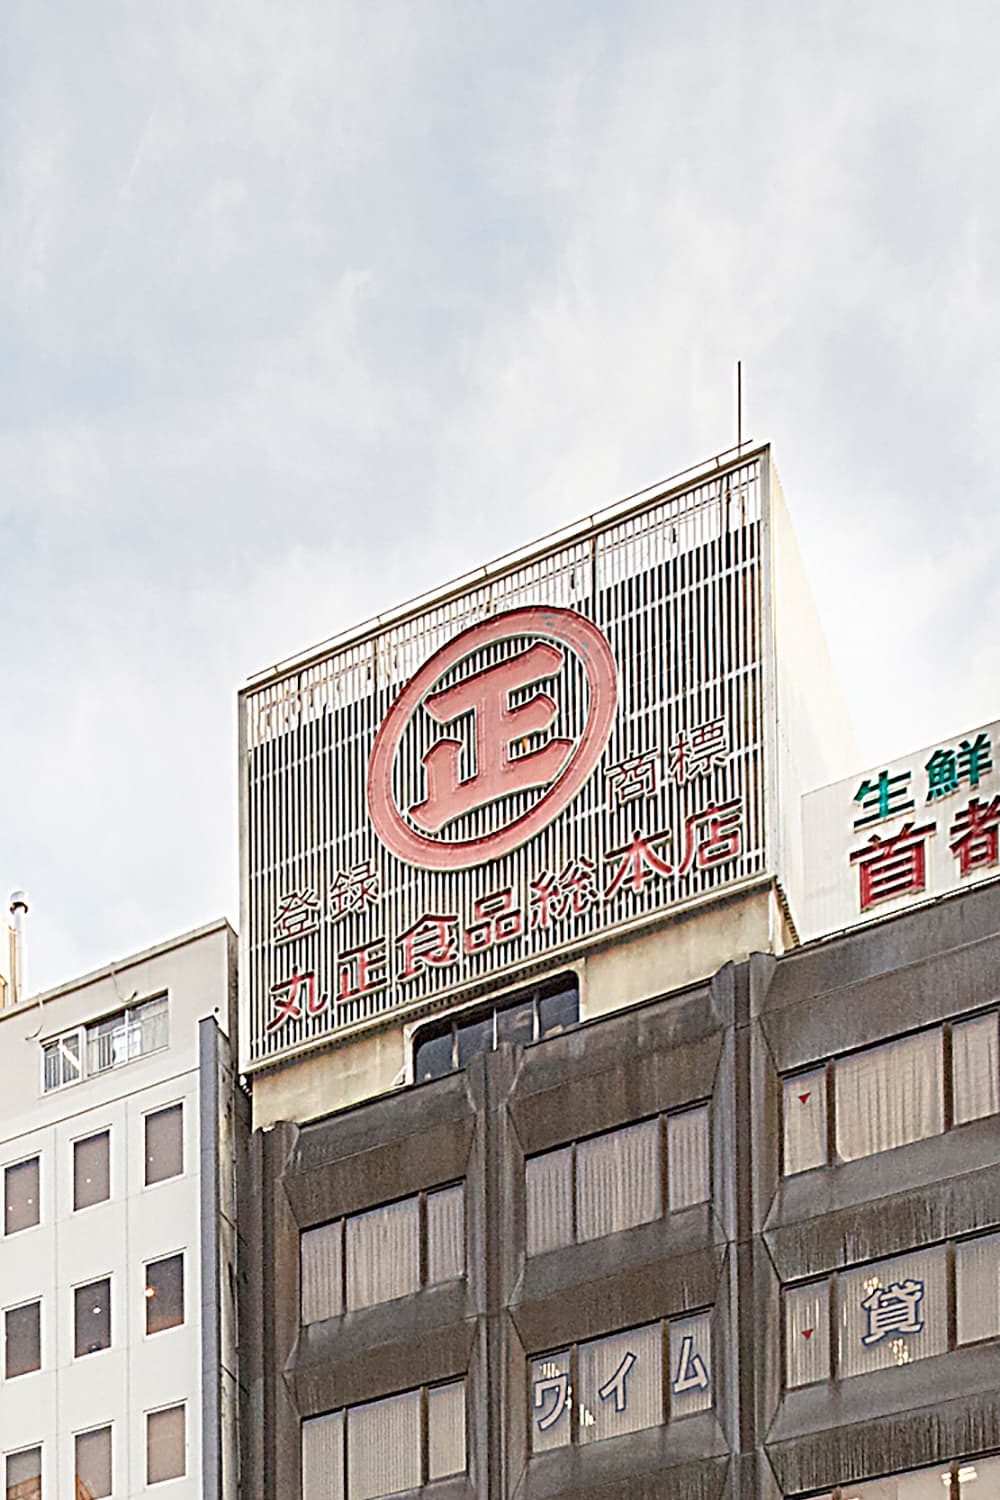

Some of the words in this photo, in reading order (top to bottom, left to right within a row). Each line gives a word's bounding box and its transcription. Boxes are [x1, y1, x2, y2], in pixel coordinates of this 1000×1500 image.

[273, 860, 380, 943] 登録
[604, 716, 730, 808] 商標
[853, 733, 993, 832] 生鮮
[266, 797, 744, 1031] 丸正食品総本店
[533, 1336, 709, 1431] ワイム
